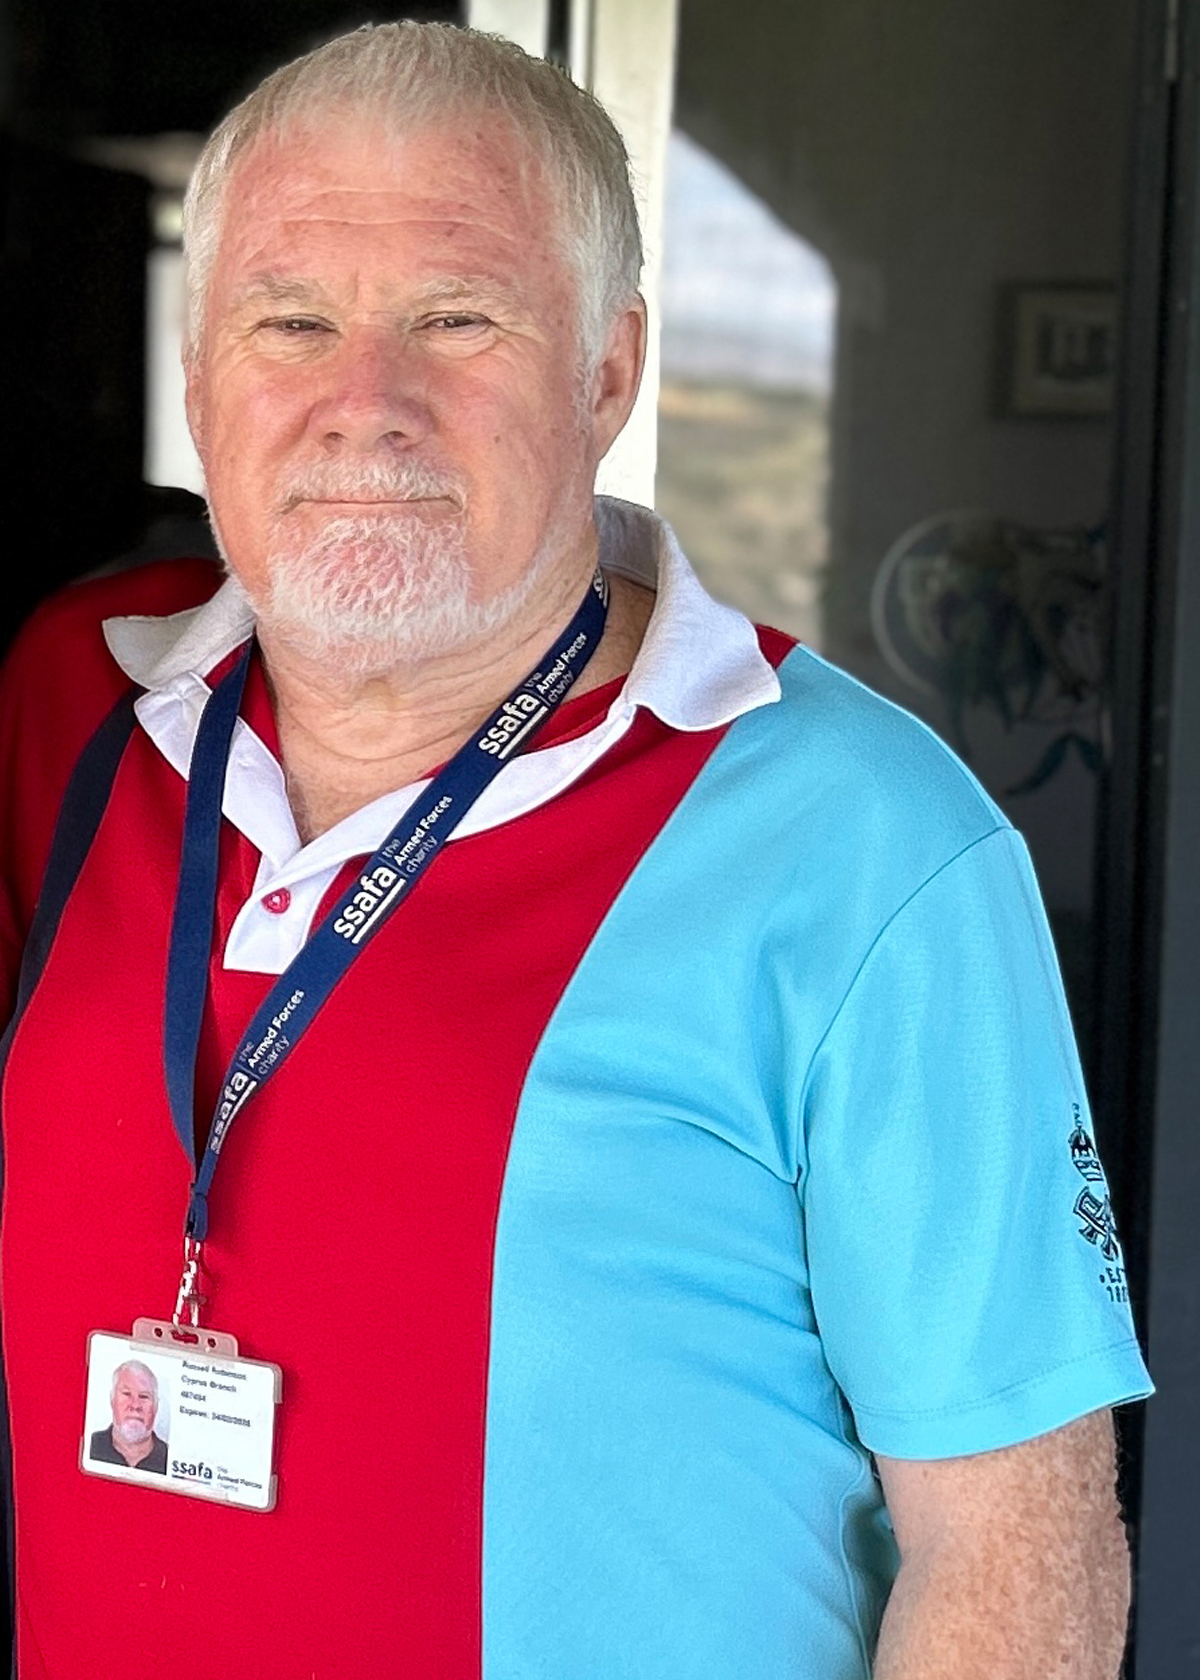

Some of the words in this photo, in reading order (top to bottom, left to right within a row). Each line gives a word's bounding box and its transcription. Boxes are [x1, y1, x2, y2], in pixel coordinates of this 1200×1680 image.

[536, 659, 566, 696] Armed
[561, 633, 588, 664] Forces
[478, 693, 541, 756] ssafa
[381, 839, 402, 858] the
[394, 827, 425, 867] Armed
[420, 796, 454, 830] Forces
[406, 836, 438, 874] charity
[333, 866, 397, 939] ssafa
[248, 1027, 277, 1069] Armed
[272, 989, 305, 1029] Forces
[258, 1035, 290, 1076] charity
[210, 1071, 250, 1152] ssafa
[181, 1374, 208, 1387] Cyprus
[209, 1380, 237, 1393] Branch
[171, 1460, 213, 1480] ssafa
